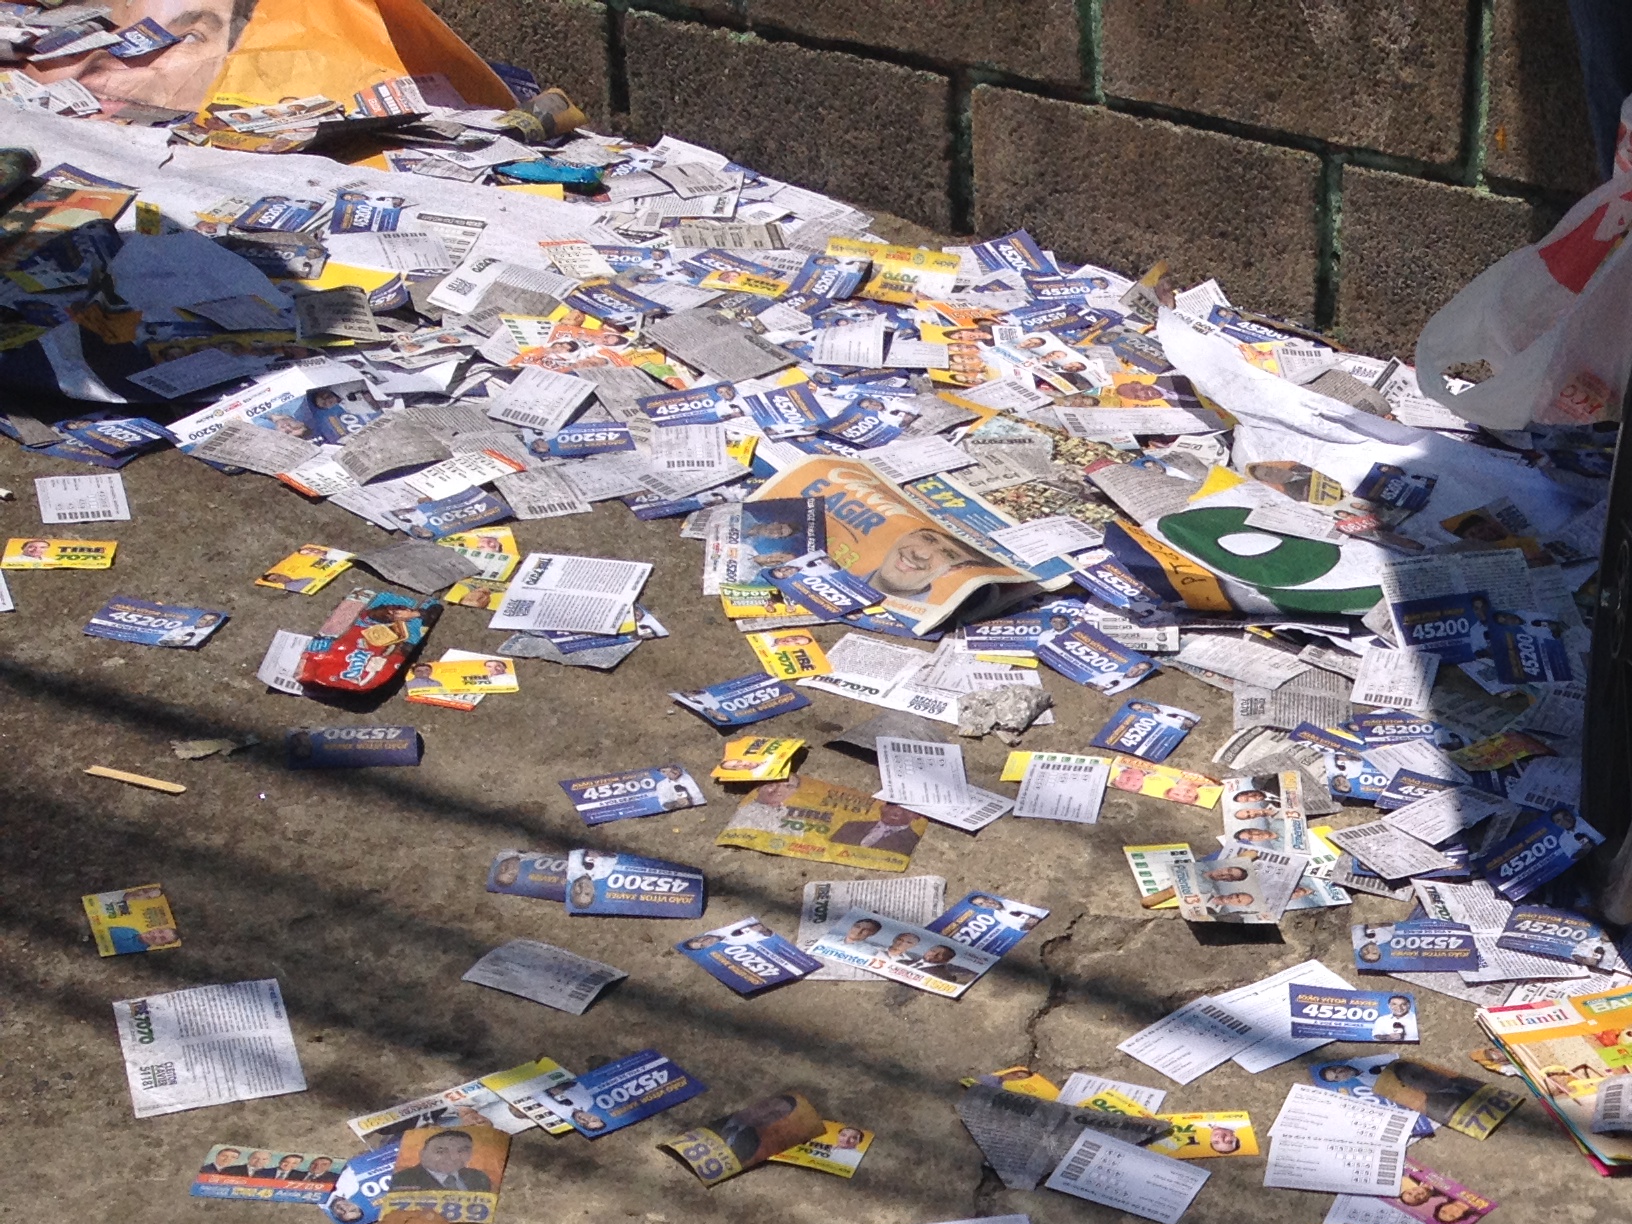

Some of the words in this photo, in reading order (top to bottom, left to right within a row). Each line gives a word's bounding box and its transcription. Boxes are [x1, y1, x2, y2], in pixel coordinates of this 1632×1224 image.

[656, 399, 715, 413] 45200
[774, 394, 805, 425] 45200
[557, 431, 621, 444] 45200
[843, 415, 879, 441] 45200
[428, 501, 488, 527] 45200
[825, 492, 886, 536] AGIR
[803, 576, 851, 606] 45200
[108, 610, 182, 629] 45200
[976, 625, 1042, 636] 45200
[1412, 618, 1470, 640] 45200
[1063, 640, 1118, 672] 45200
[1518, 632, 1540, 676] 45200
[722, 686, 780, 712] 45200
[1120, 717, 1157, 746] 45200
[1371, 723, 1434, 736] 45200
[582, 777, 656, 800] 45200
[1500, 832, 1559, 879] 45200
[607, 873, 690, 893] 45200
[956, 914, 997, 947] 5200
[1390, 936, 1463, 950] 45200
[1515, 919, 1588, 941] 45200
[723, 945, 781, 978] 45200
[1302, 1004, 1378, 1022] 45200
[1498, 1009, 1570, 1028] infantil
[140, 1065, 151, 1091] 51181
[597, 1069, 669, 1109] 45200
